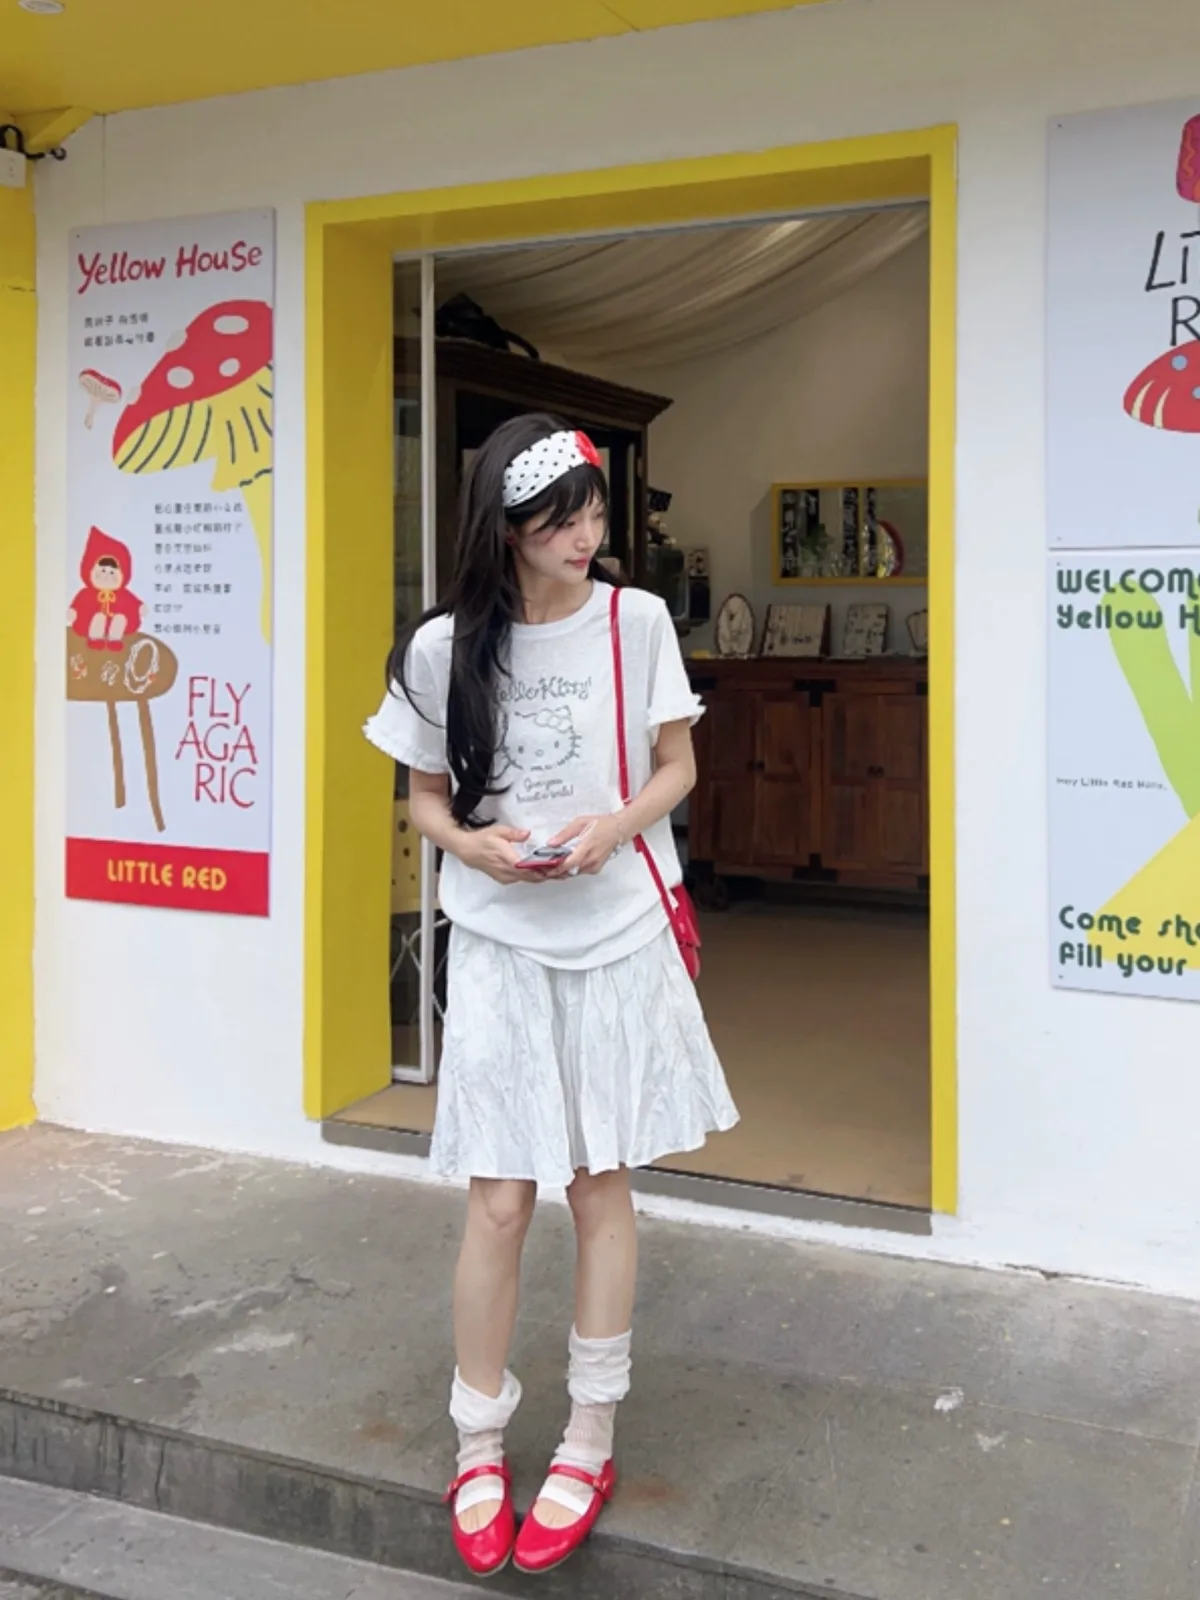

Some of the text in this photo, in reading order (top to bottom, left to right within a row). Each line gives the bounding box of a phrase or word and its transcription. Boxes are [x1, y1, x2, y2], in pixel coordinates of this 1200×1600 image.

[78, 251, 166, 295] Yellow
[1145, 230, 1200, 292] LI
[1057, 567, 1200, 601] WELCOM
[1056, 603, 1163, 630] Yellow
[188, 675, 251, 726] FLY
[174, 720, 258, 764] AGA
[194, 762, 257, 809] RIC
[106, 858, 227, 892] LITTLE RED
[1058, 904, 1142, 941] Come
[1117, 952, 1188, 978] your
